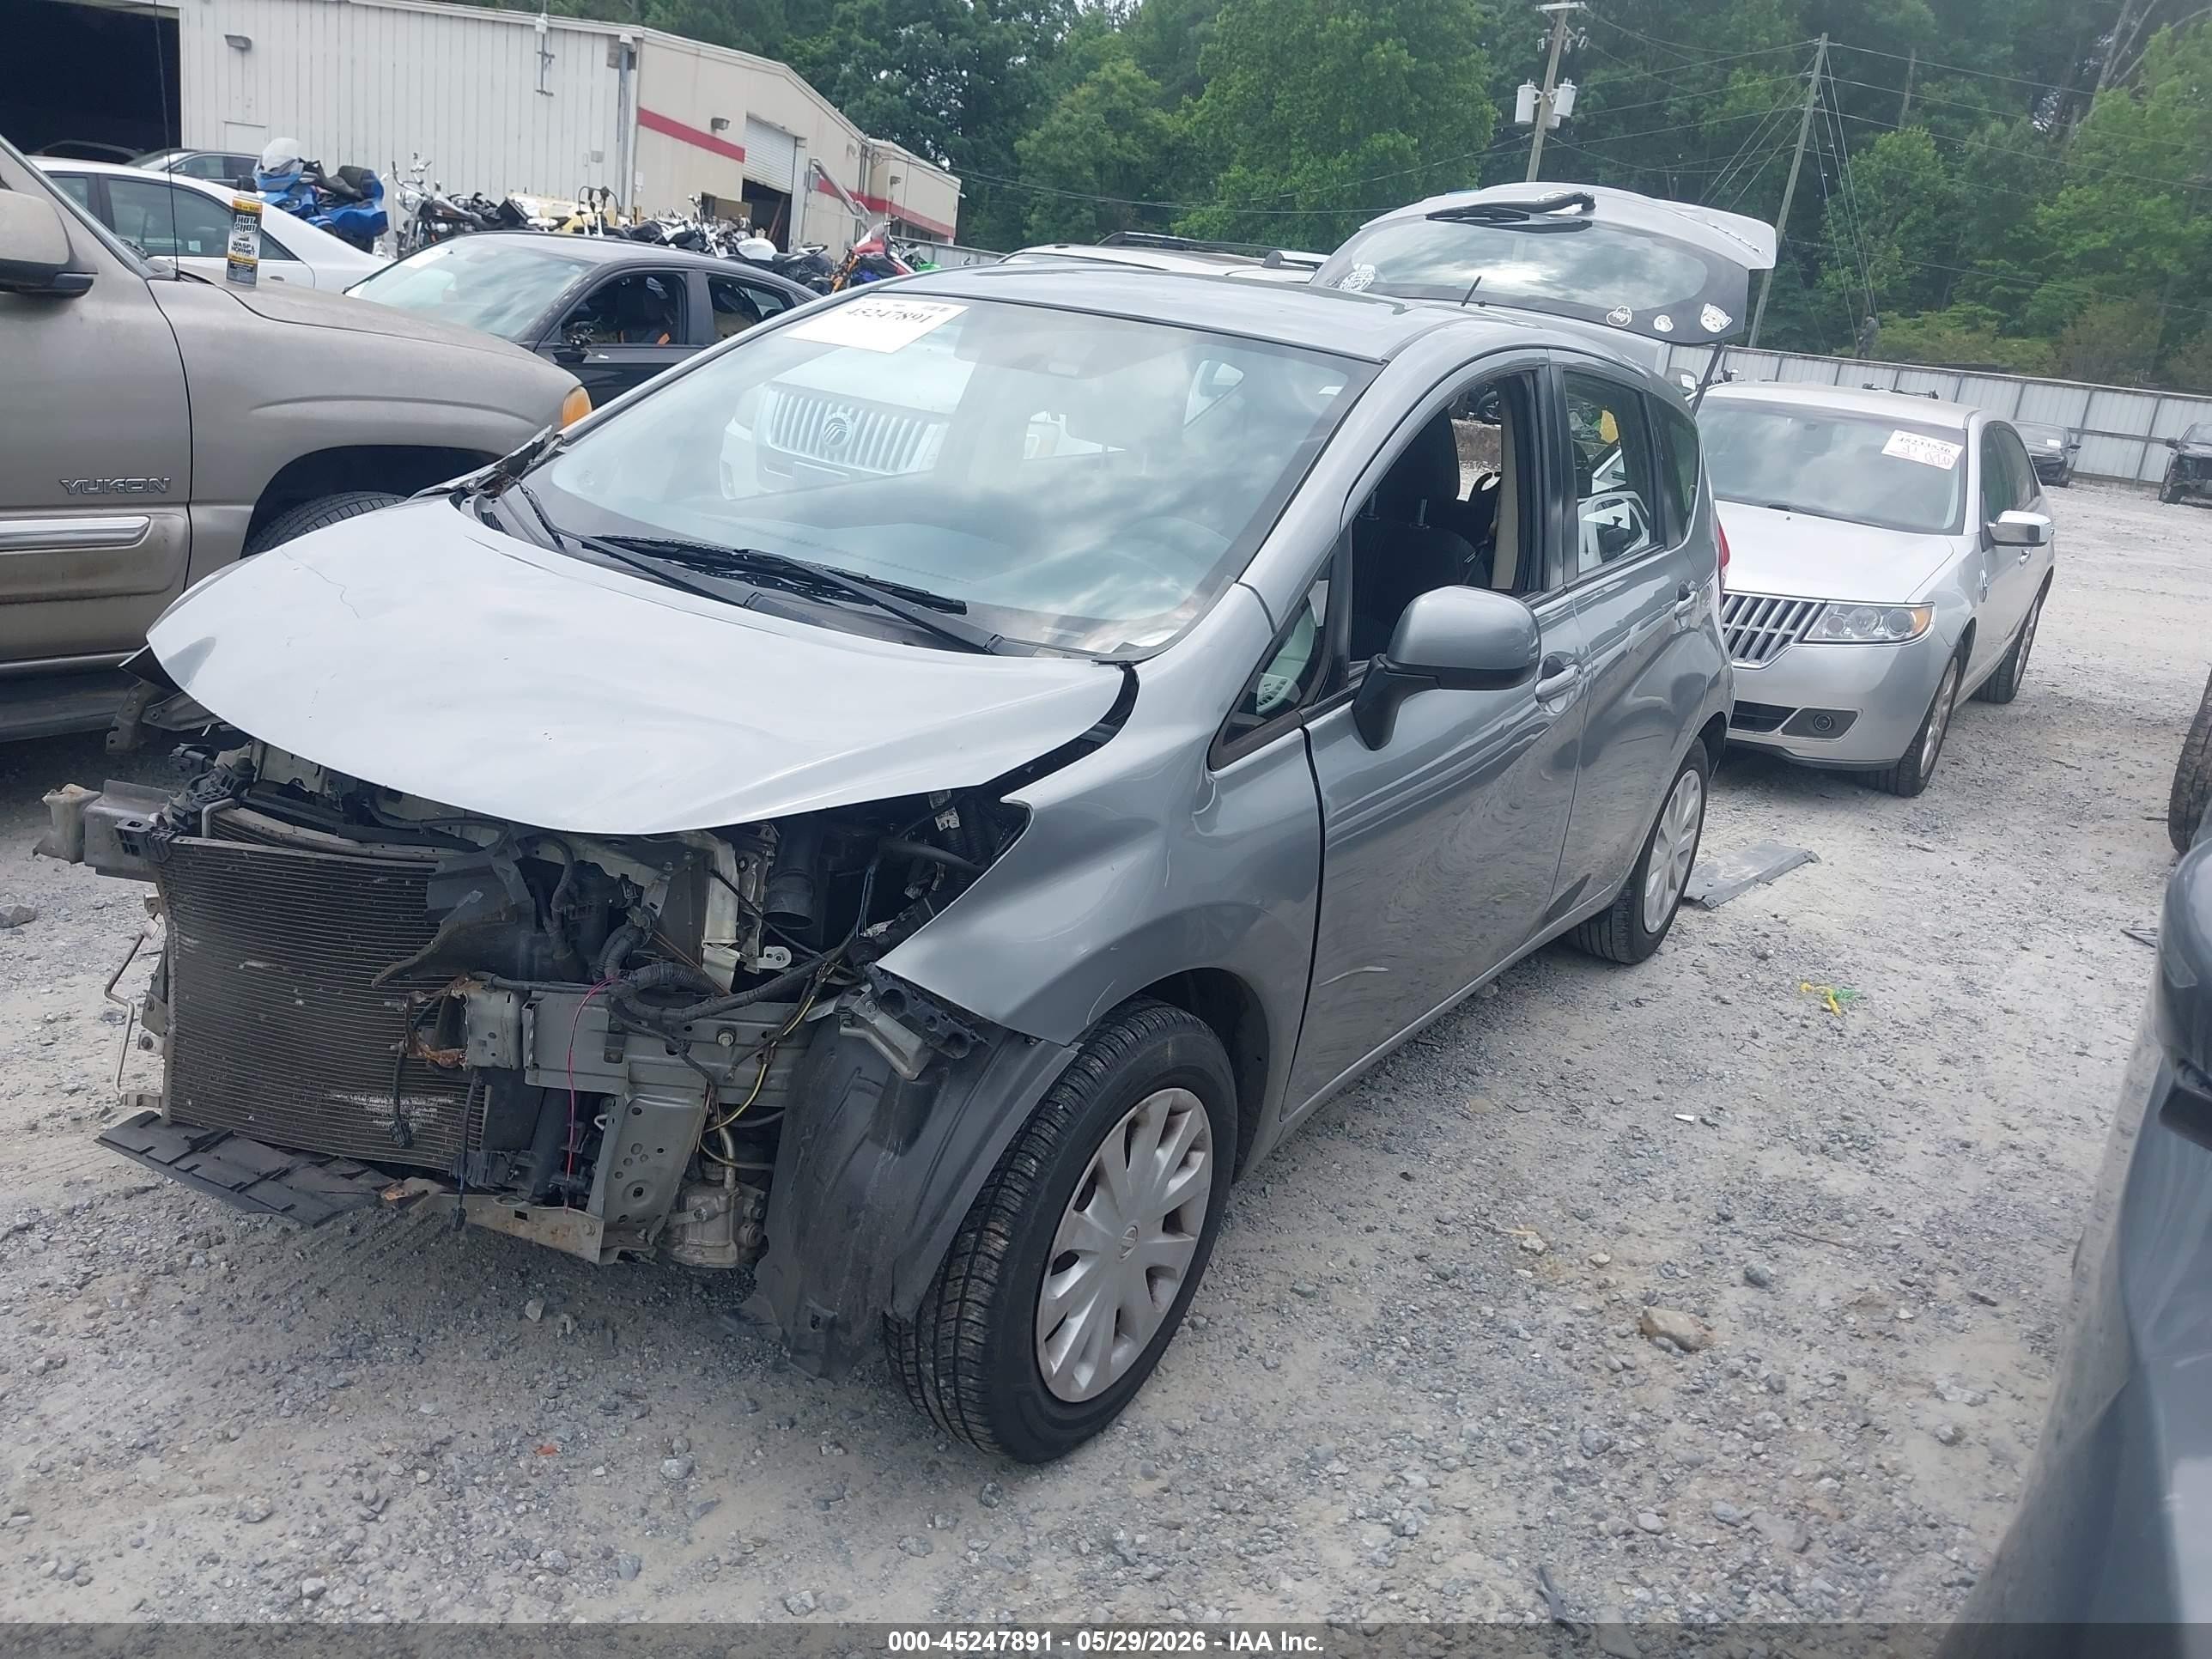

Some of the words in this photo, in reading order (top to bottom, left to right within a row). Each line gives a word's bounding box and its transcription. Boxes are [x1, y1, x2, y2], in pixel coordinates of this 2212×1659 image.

[236, 215, 256, 225] HOT
[234, 223, 258, 234] SHOT
[233, 240, 251, 250] WASP
[231, 246, 256, 256] HORNET
[60, 477, 171, 495] YUKON
